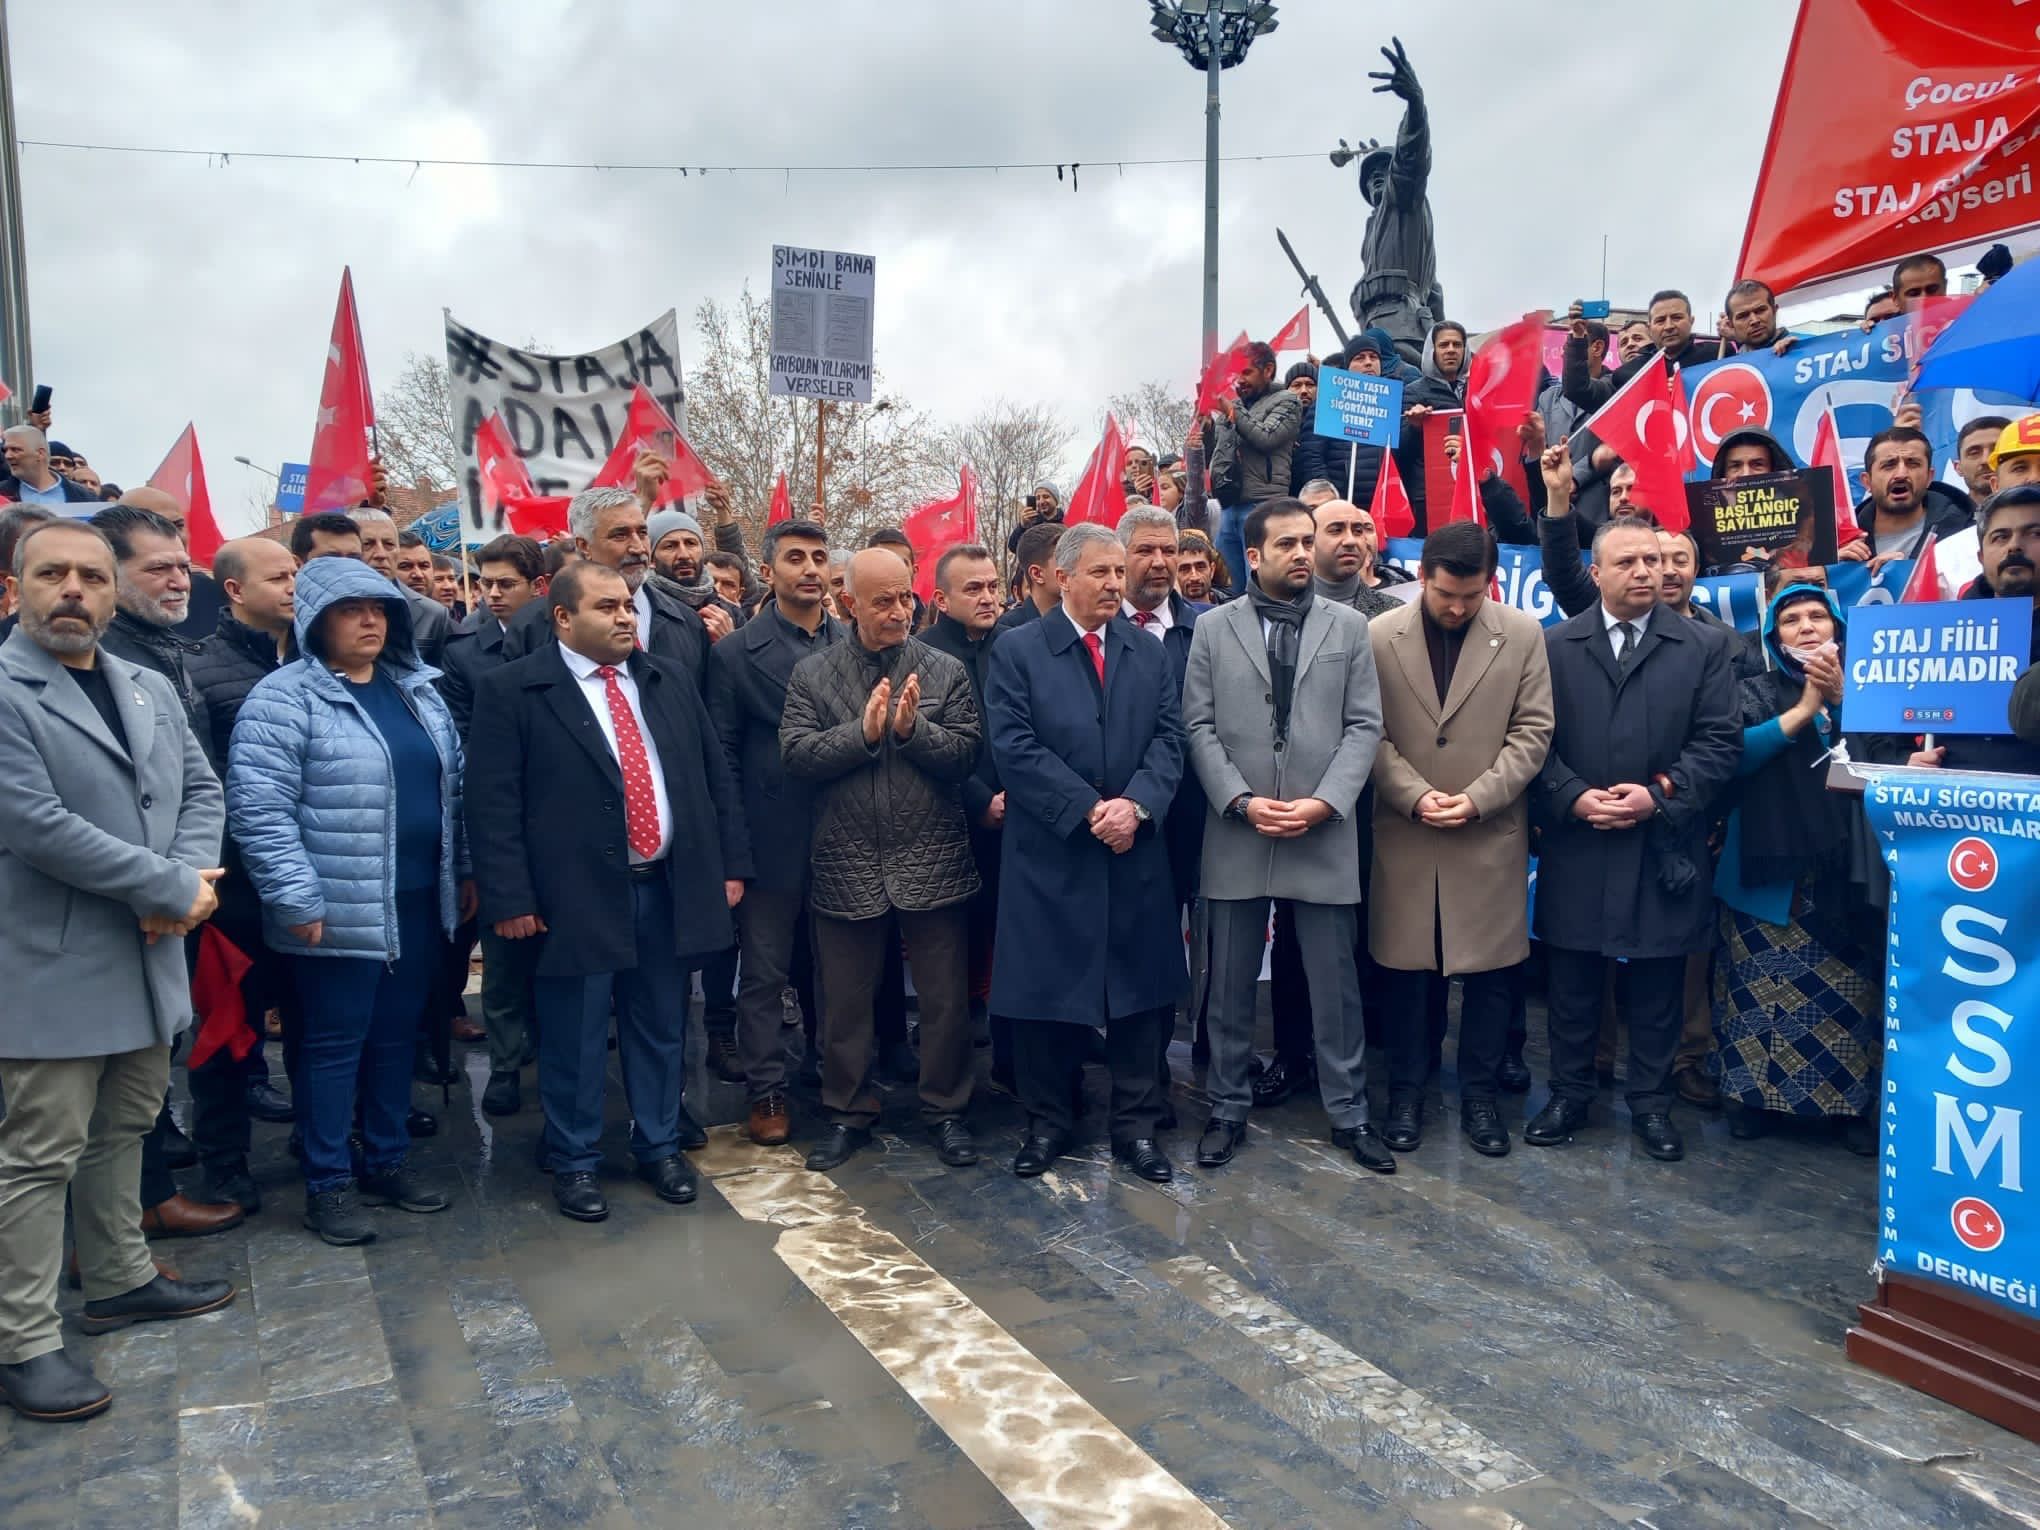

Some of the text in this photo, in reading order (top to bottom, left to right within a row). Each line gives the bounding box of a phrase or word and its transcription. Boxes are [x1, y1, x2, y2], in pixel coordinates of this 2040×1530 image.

[1891, 116, 2009, 158] STAJA
[1833, 182, 1921, 218] STAJ
[775, 247, 873, 275] ŞİMDİ BANA
[785, 269, 843, 290] SENİNLE
[770, 355, 870, 380] KAYBOLAN YILLARIMI
[1794, 342, 1870, 384] STAJ
[785, 376, 856, 398] VERSELER
[1714, 498, 1800, 520] BAŞLANGIÇ
[1737, 487, 1775, 504] STAJ
[1716, 511, 1797, 533] SAYILMALI
[1872, 617, 1999, 655] STAJ FİİLİ
[1852, 655, 2018, 691] ÇALIŞMADIR
[1875, 785, 2040, 813] STAJ SİGORTA
[1884, 1079, 1898, 1263] DAYANIŞMA
[1917, 1251, 2038, 1309] DERNEĞİ
